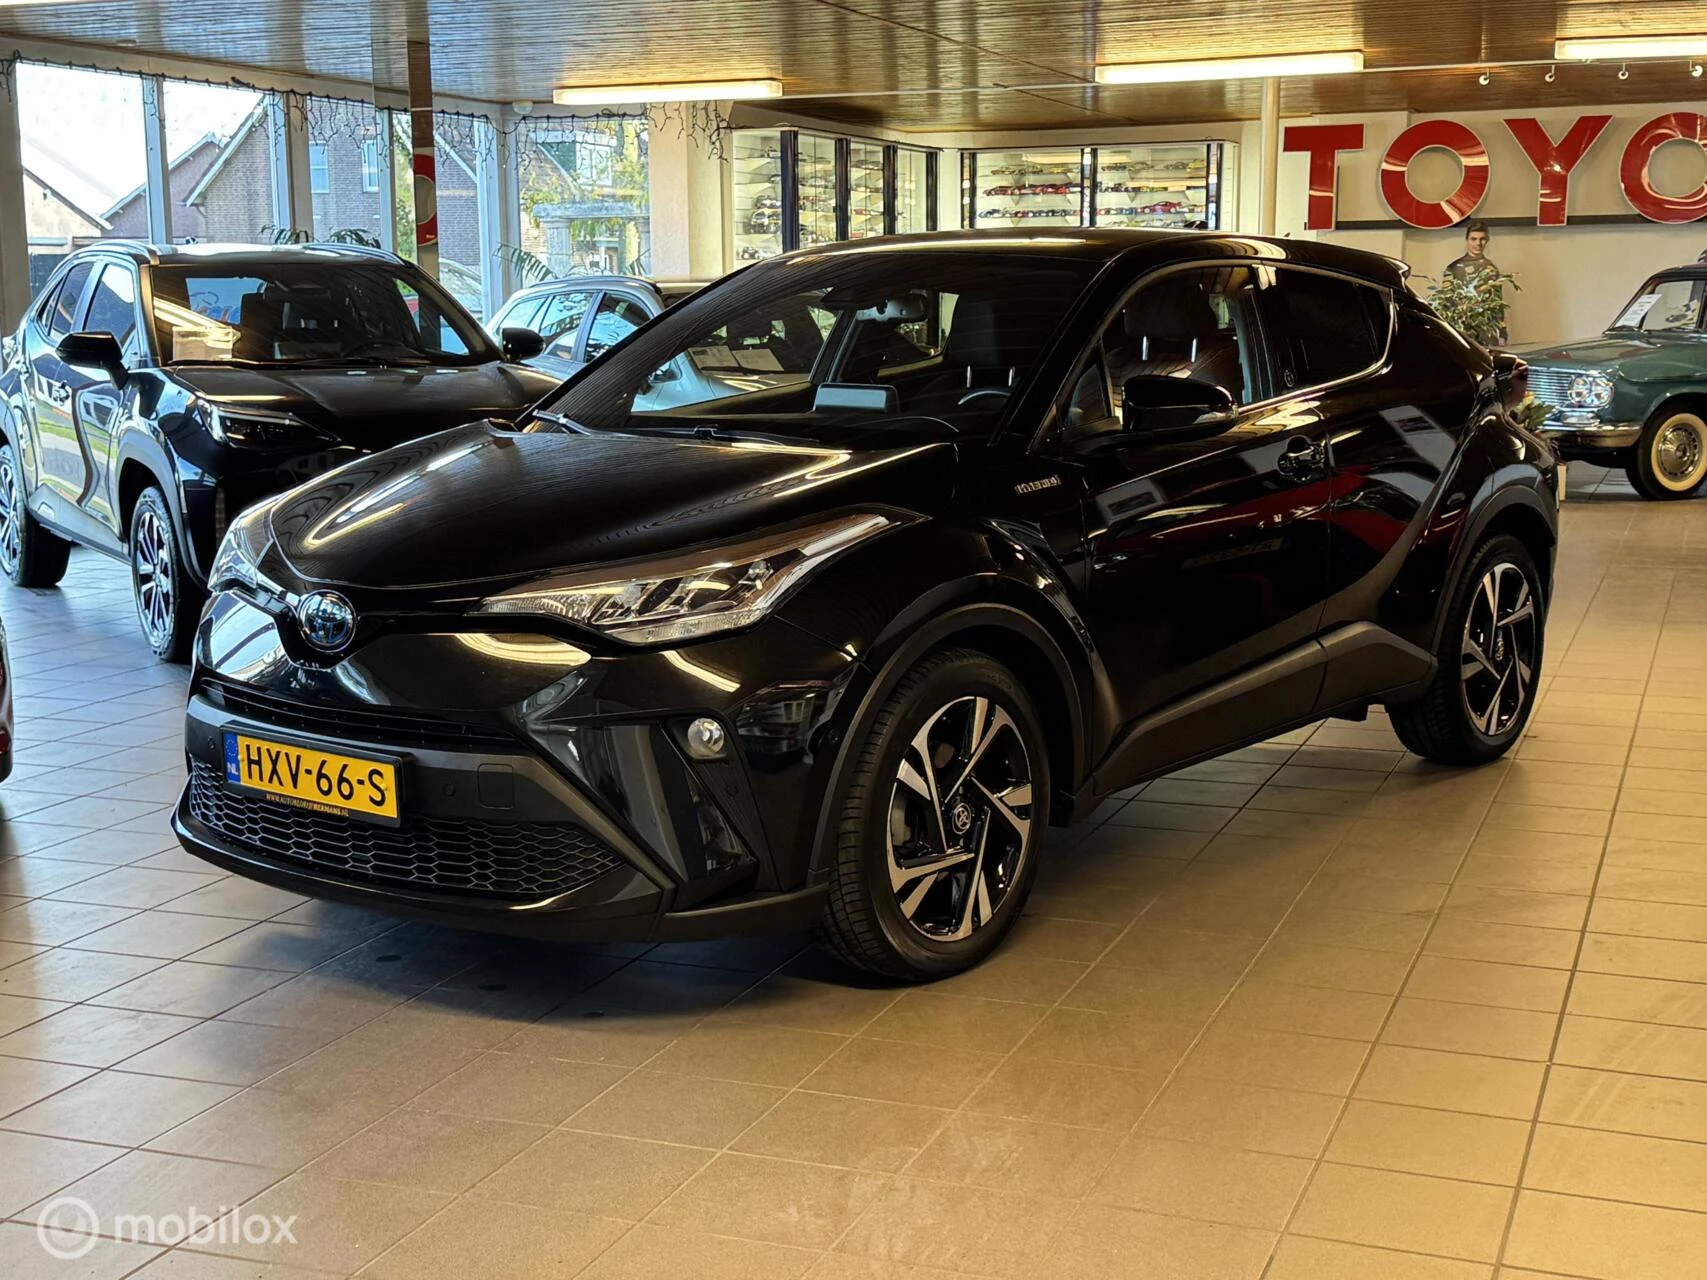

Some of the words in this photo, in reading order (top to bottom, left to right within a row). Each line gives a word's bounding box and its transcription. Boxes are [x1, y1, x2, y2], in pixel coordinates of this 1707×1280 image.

[1283, 112, 1707, 230] TOYO
[227, 762, 239, 775] NL
[245, 743, 387, 807] HXV-66-S
